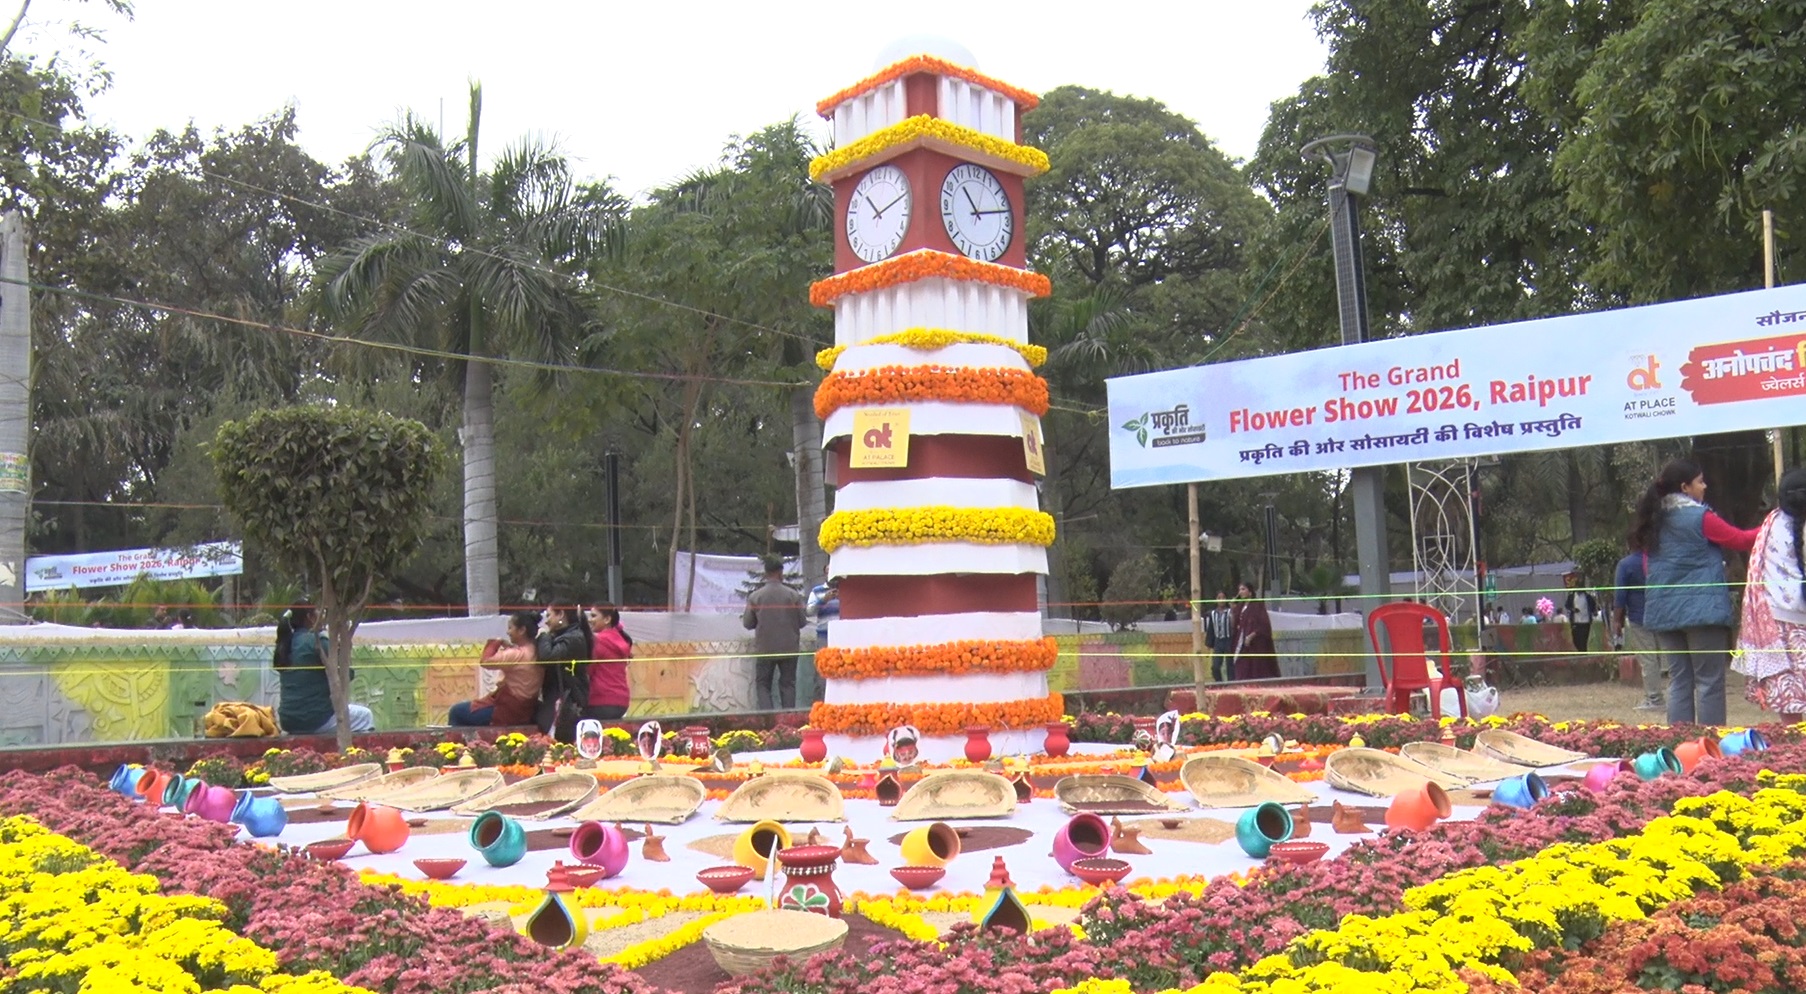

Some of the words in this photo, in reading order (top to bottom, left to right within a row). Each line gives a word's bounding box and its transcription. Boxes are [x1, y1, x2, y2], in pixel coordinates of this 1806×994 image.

[973, 167, 981, 180] 12
[943, 199, 949, 211] 9
[1000, 195, 1006, 207] 2
[948, 221, 954, 232] 8
[1004, 216, 1010, 228] 3
[975, 249, 981, 260] 6
[990, 247, 996, 259] 5
[1701, 346, 1795, 381] अनोपचंद
[1338, 371, 1380, 391] The
[1387, 358, 1460, 386] Grand
[1229, 406, 1317, 433] Flower
[1324, 397, 1398, 423] Show
[1406, 384, 1480, 414] 2026,
[1490, 374, 1591, 407] Raipur
[1624, 401, 1637, 412] AT
[1640, 397, 1676, 410] PLACE
[1151, 404, 1189, 435] प्रकृति
[1625, 411, 1652, 420] KOTWALI
[1652, 409, 1676, 418] CHOWK
[1156, 438, 1171, 446] back
[1180, 435, 1201, 444] nature
[1239, 443, 1284, 464] प्रकृति
[1288, 440, 1310, 457] की
[1315, 437, 1345, 455] ओर
[1349, 427, 1429, 451] सोसायटी
[1434, 424, 1458, 442] की
[1463, 420, 1514, 440] विशेष
[1519, 412, 1583, 437] प्रस्तुति
[118, 554, 133, 562] The
[72, 565, 108, 576] Flower
[110, 562, 137, 573] Show
